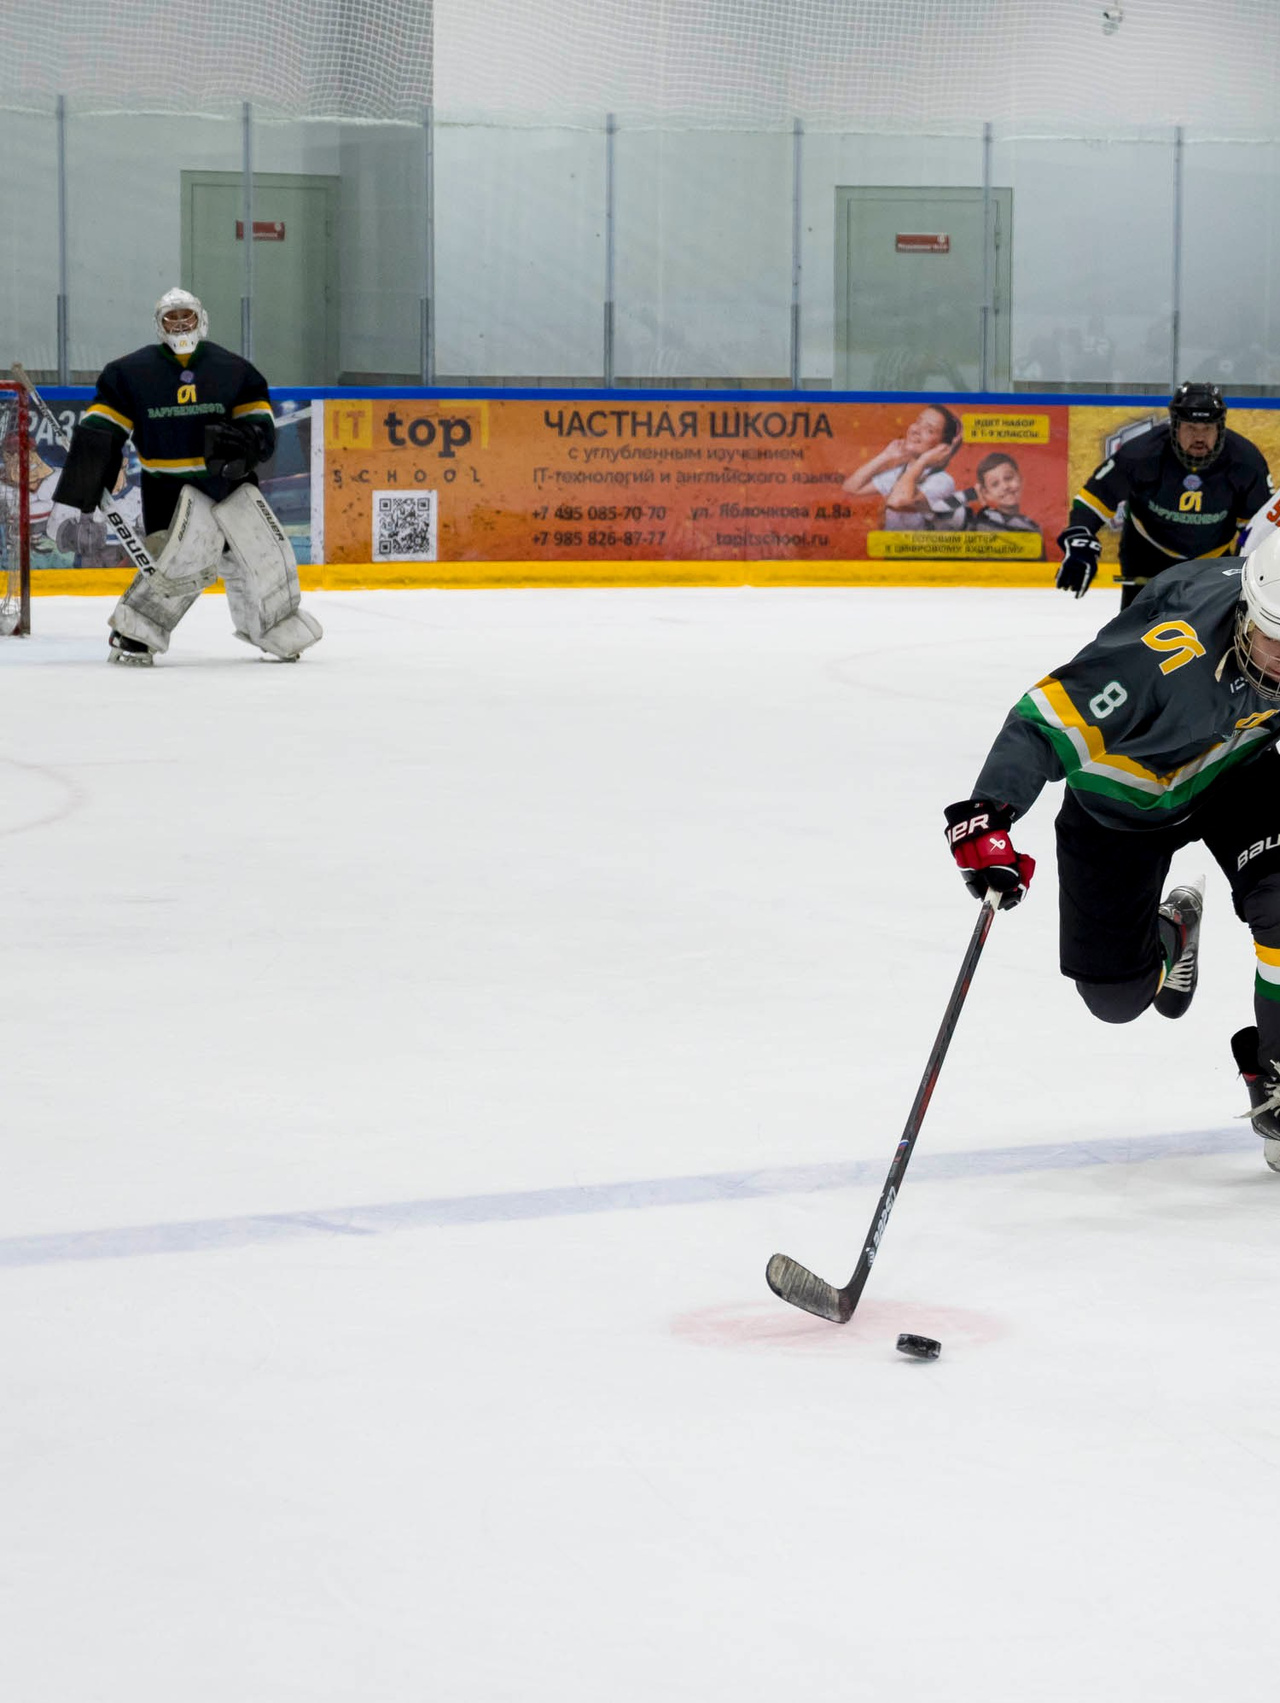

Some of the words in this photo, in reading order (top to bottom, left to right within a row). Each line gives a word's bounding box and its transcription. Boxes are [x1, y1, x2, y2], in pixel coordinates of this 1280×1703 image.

[333, 411, 365, 439] IT
[384, 412, 471, 458] top
[544, 410, 698, 438] ЧАСТНАЯ
[709, 411, 834, 439] ШКОЛА
[582, 443, 702, 463] углубленным
[554, 505, 582, 521] 495
[587, 505, 666, 521] 085-70-70
[554, 531, 582, 547] 985
[587, 531, 667, 547] 826-87-77
[1071, 538, 1102, 551] CC
[1089, 680, 1128, 719] 8
